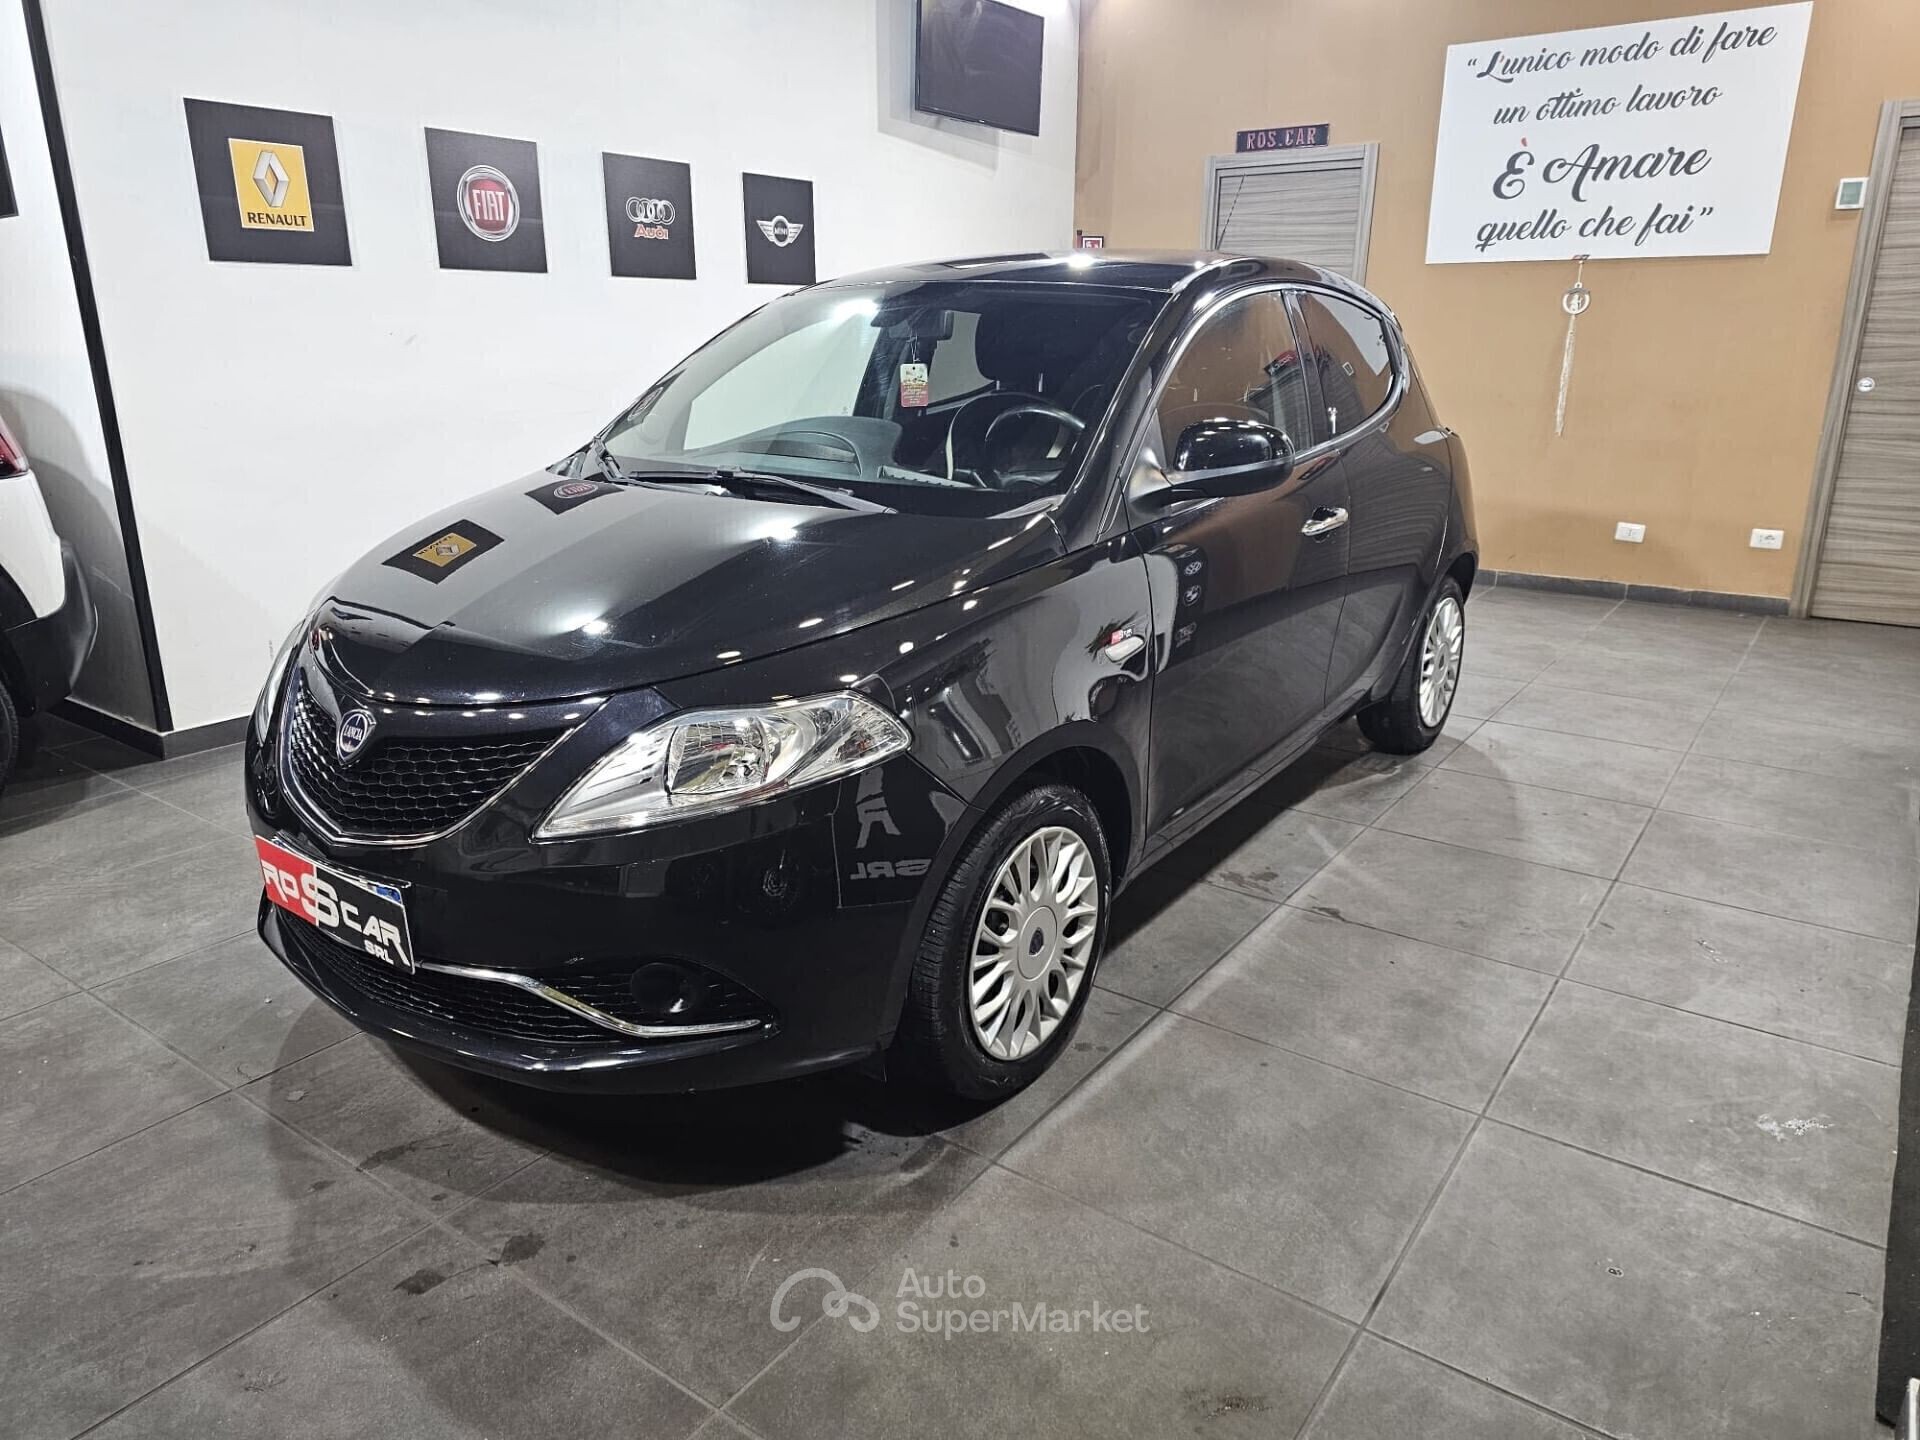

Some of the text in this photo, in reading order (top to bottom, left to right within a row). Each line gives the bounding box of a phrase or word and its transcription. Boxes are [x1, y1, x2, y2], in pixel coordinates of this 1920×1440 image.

[1579, 32, 1663, 67] modo
[1669, 25, 1704, 57] di
[1702, 21, 1778, 64] fare
[1493, 84, 1723, 125] un ottimo lavoro
[1492, 136, 1712, 203] È Amare
[247, 212, 307, 227] RENAULT
[472, 189, 505, 221] FIAT
[634, 223, 669, 240] Audi
[1475, 208, 1572, 252] quello
[1578, 205, 1636, 238] che
[364, 939, 394, 965] SRL
